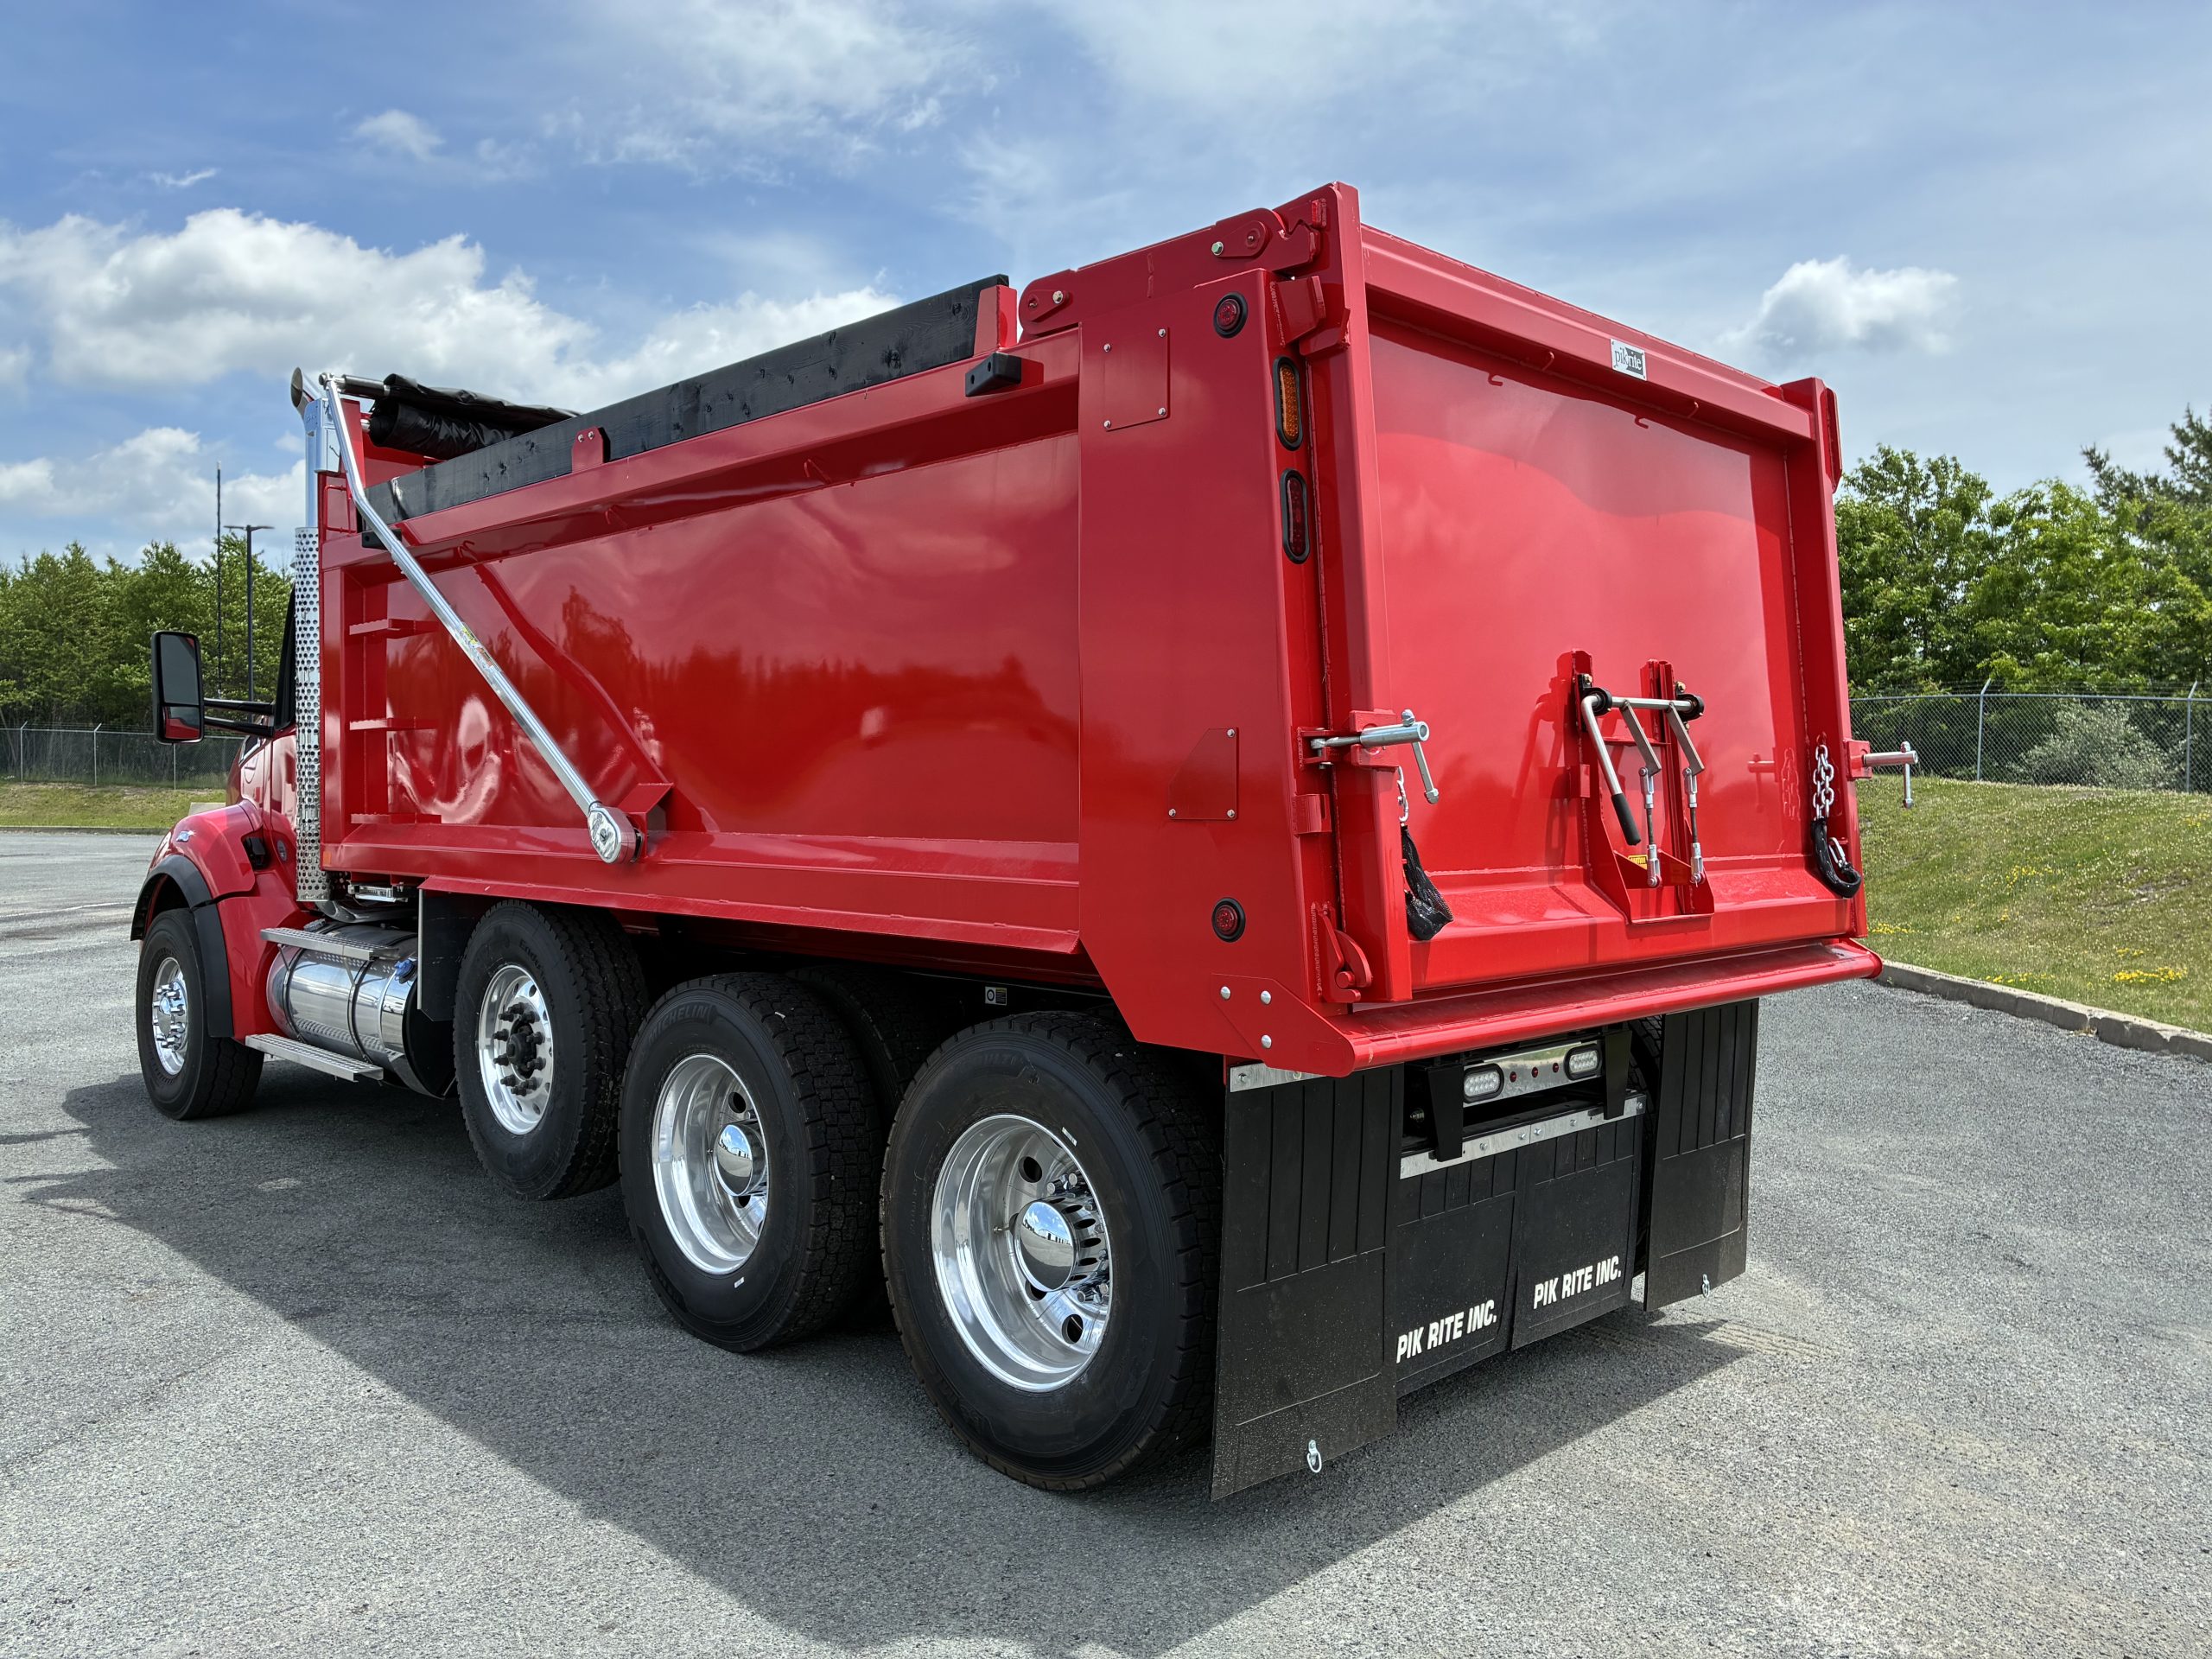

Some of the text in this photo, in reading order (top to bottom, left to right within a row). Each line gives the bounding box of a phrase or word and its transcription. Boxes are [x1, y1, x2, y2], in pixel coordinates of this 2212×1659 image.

[647, 1004, 709, 1045] MICHELIN
[1534, 1255, 1622, 1309] PIK RITE INC.
[1396, 1299, 1497, 1363] PIK RITE INC.
